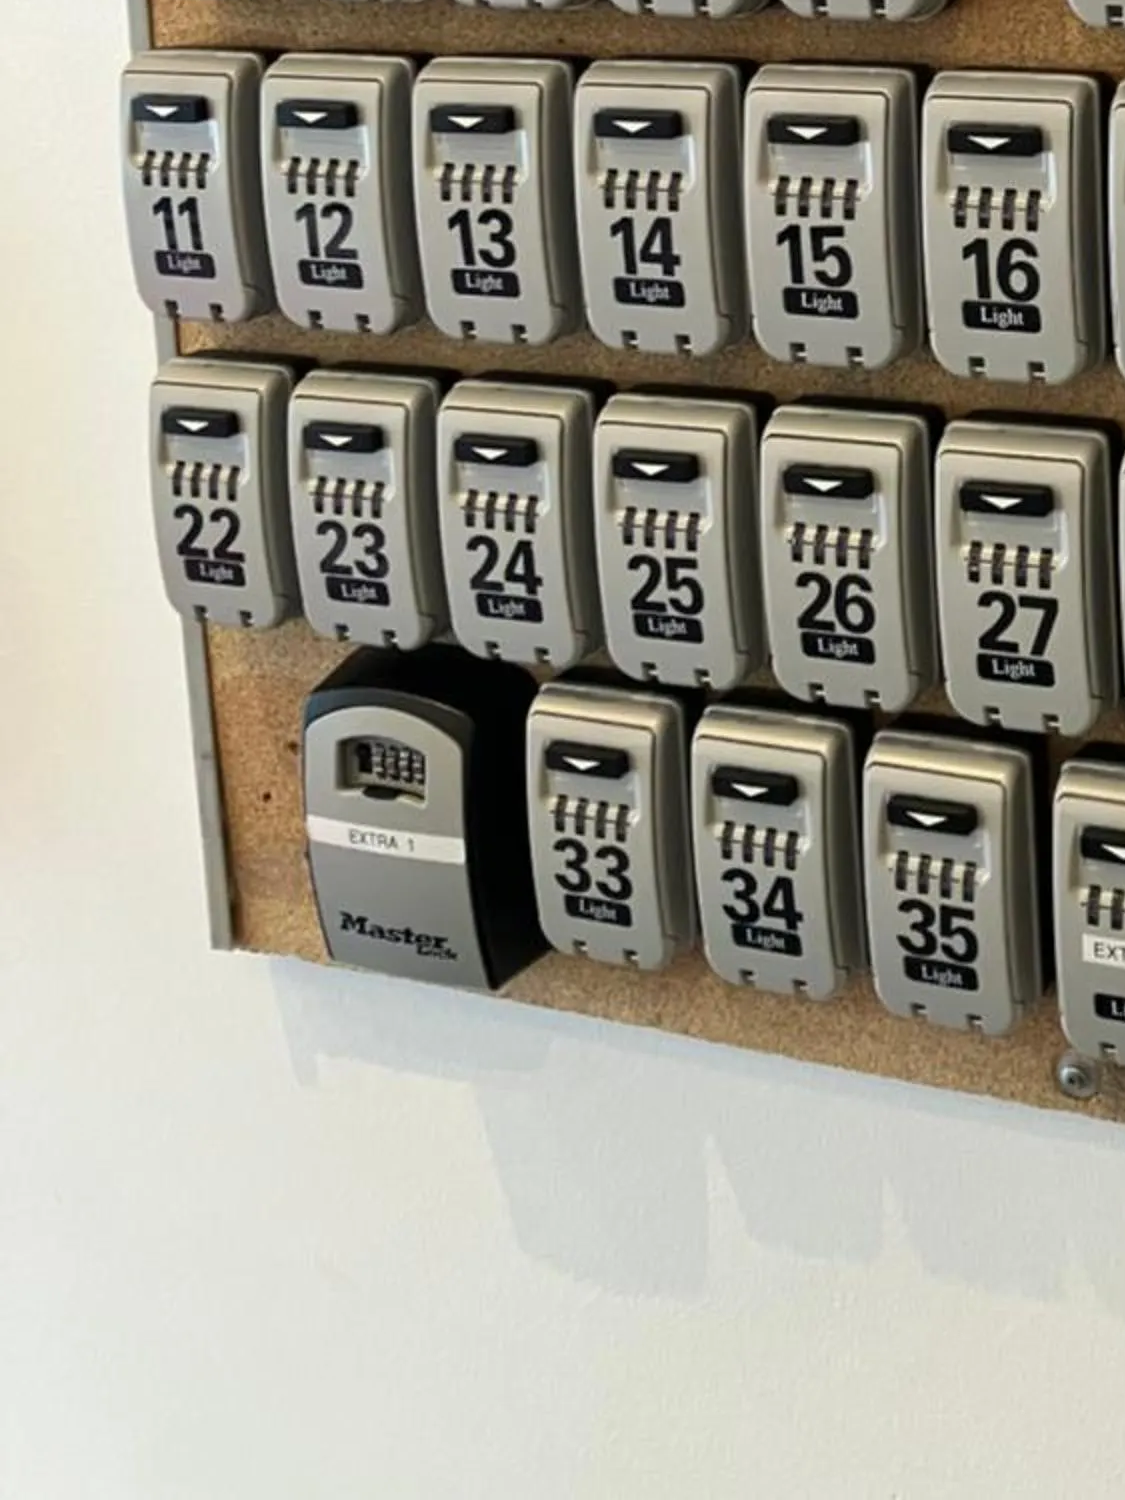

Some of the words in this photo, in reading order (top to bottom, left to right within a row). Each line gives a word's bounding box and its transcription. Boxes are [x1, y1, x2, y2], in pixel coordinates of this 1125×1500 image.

[153, 197, 203, 251] 11
[295, 202, 358, 259] 12
[448, 208, 515, 268] 13
[610, 217, 680, 277] 14
[777, 224, 852, 287] 15
[167, 256, 201, 273] Light
[311, 264, 346, 282] Light
[962, 238, 1040, 302] 16
[465, 274, 504, 291] Light
[630, 284, 669, 302] Light
[801, 293, 843, 312] Light
[980, 307, 1024, 326] Light
[173, 504, 245, 563] 22
[316, 521, 389, 578] 23
[200, 563, 235, 581] Light
[466, 535, 542, 596] 24
[341, 583, 378, 601] Light
[628, 555, 703, 615] 25
[489, 599, 525, 616] Light
[795, 572, 875, 633] 26
[648, 617, 688, 636] Light
[977, 592, 1059, 656] 27
[817, 637, 860, 656] Light
[992, 660, 1036, 678] Light
[348, 830, 399, 851] EXTRA
[408, 839, 415, 852] 1
[553, 838, 633, 900] 33
[578, 900, 618, 920] Light
[722, 868, 803, 930] 34
[339, 911, 449, 950] Master
[746, 929, 786, 949] Light
[898, 899, 979, 964] 35
[921, 965, 962, 986] Light
